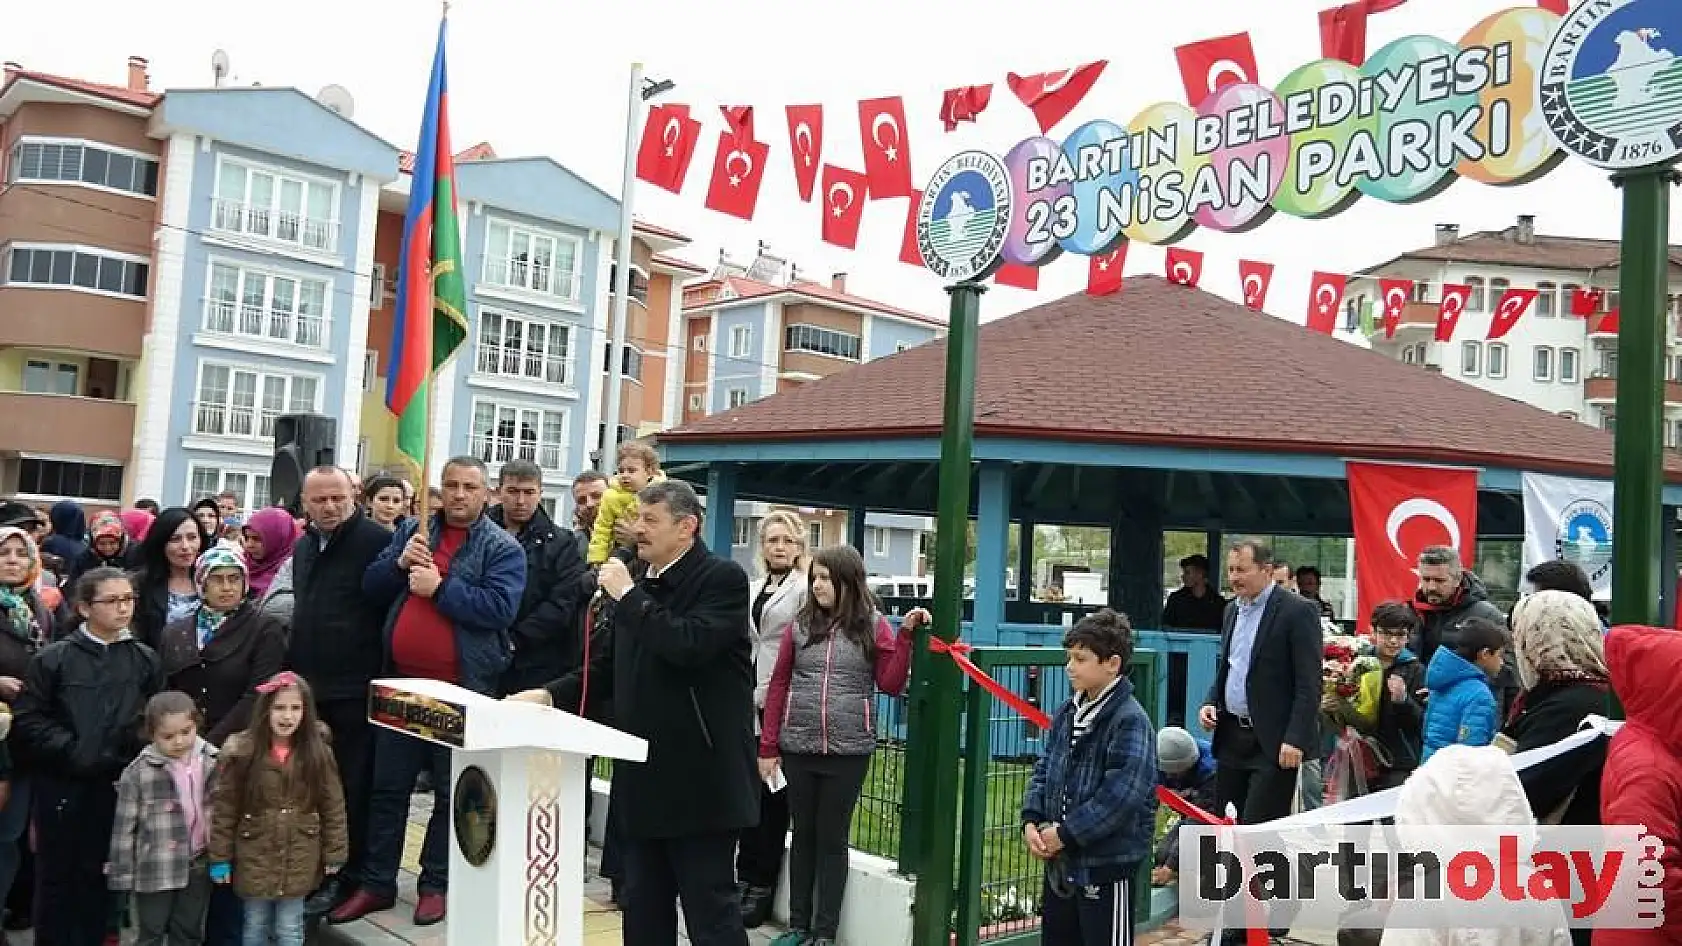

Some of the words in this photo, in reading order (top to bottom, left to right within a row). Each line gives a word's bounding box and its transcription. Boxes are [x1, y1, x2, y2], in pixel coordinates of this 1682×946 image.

[1025, 195, 1078, 244] 23
[1297, 98, 1510, 194] PARKI
[1027, 122, 1177, 193] BARTIN
[1194, 42, 1512, 155] BELEDİYESİ
[1619, 139, 1662, 160] 1876
